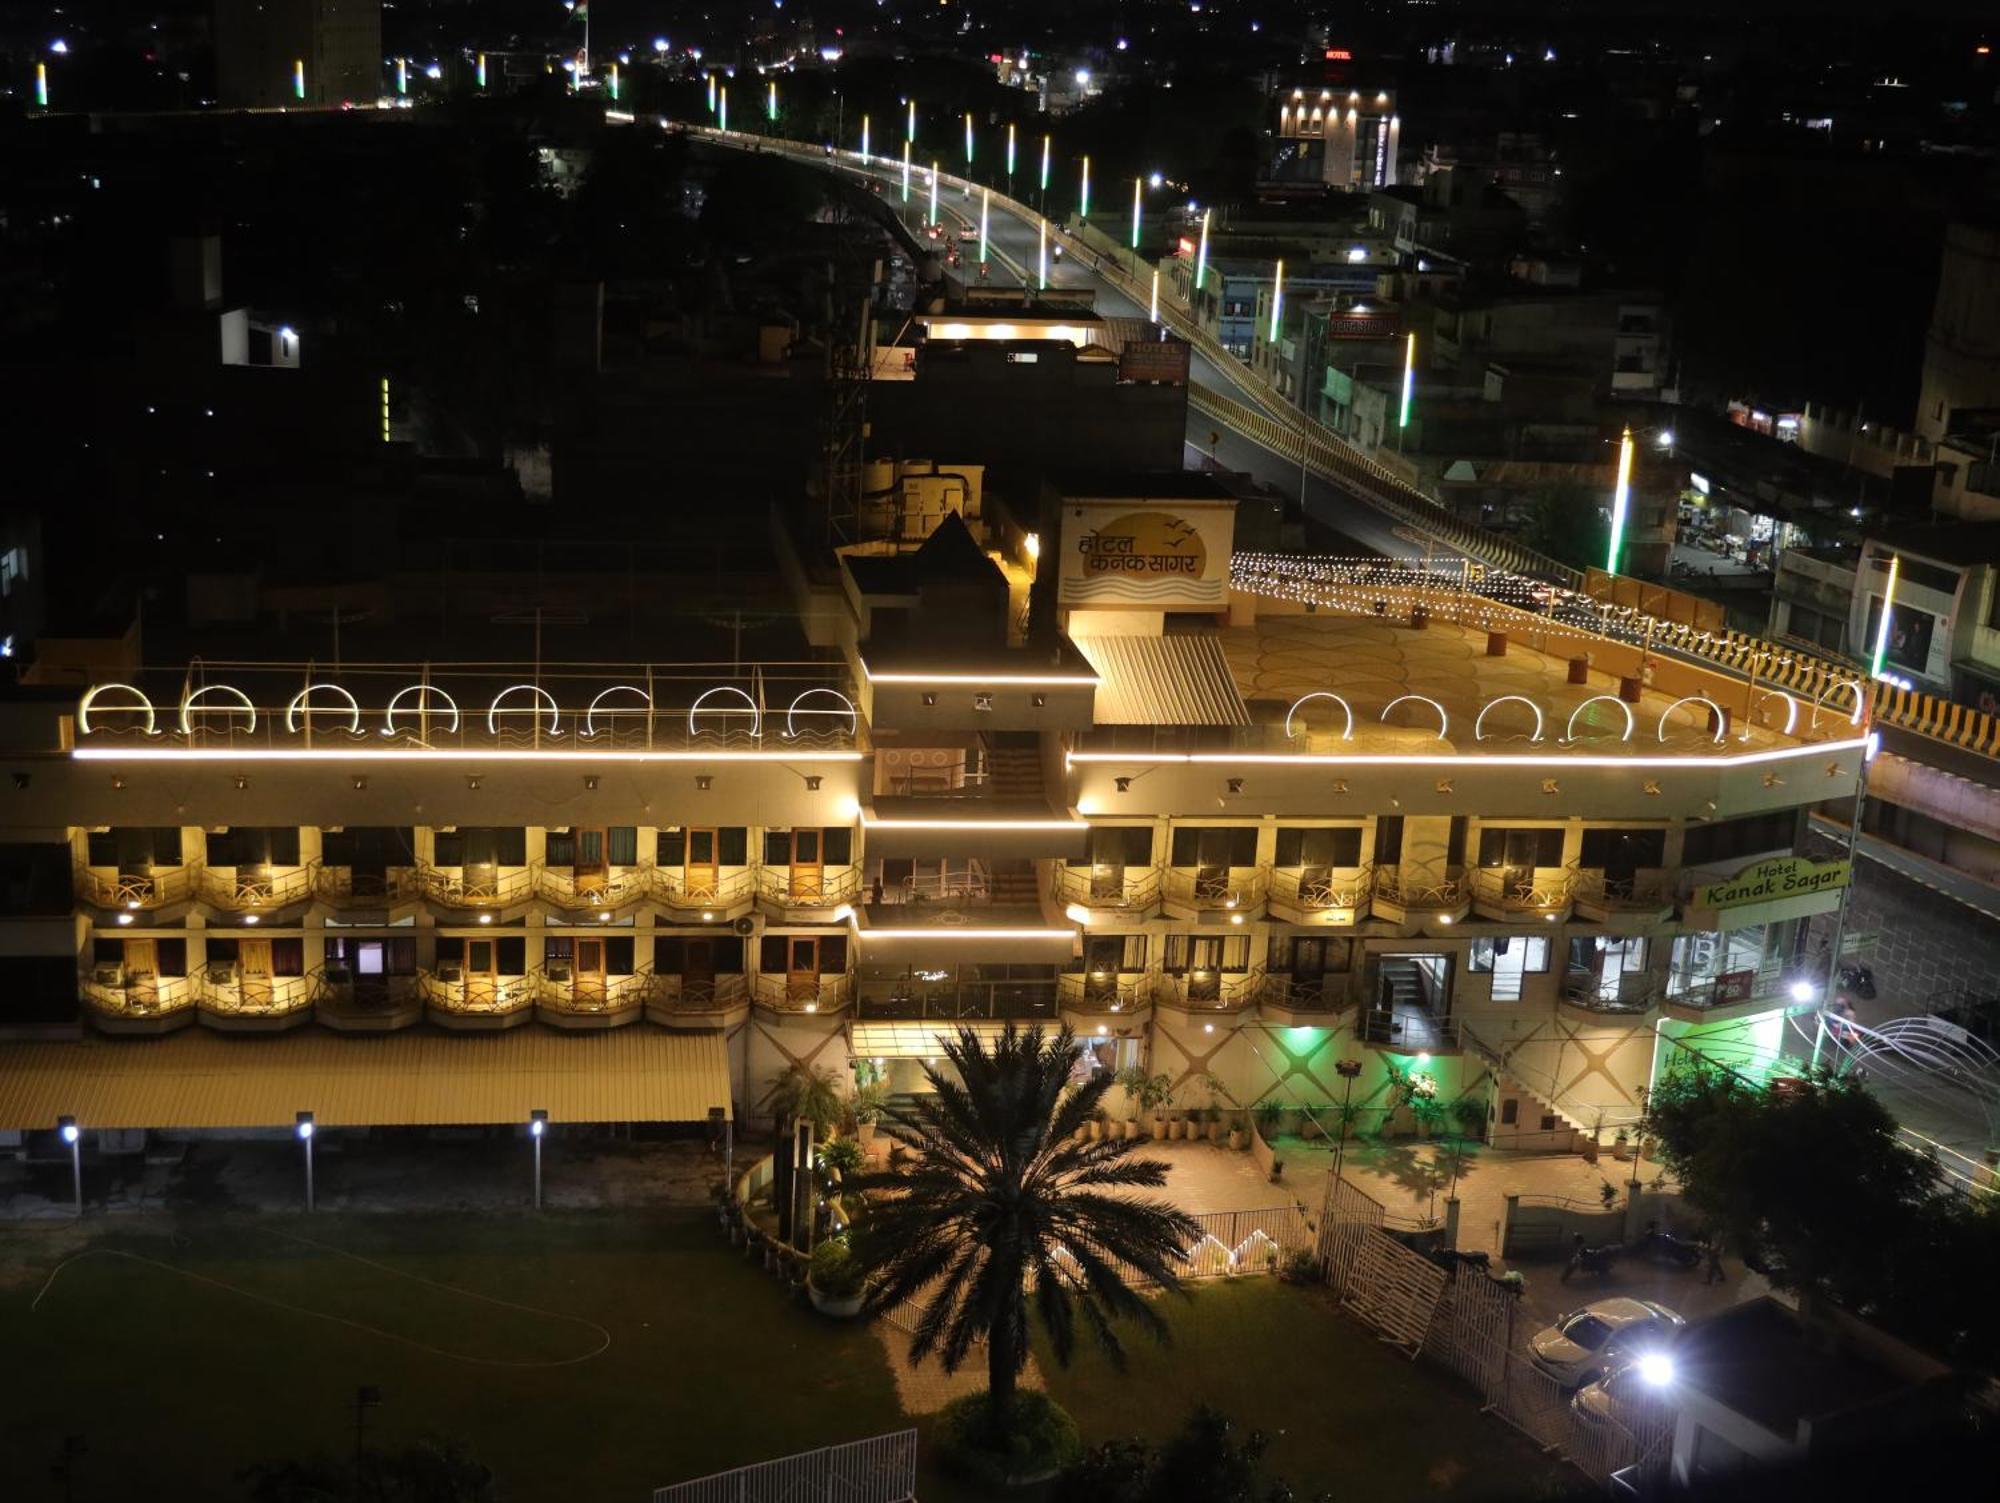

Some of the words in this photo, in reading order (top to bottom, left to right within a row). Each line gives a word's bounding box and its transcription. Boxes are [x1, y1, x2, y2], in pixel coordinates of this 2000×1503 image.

[1078, 529, 1136, 554] होटल
[1090, 554, 1147, 571] कनक
[1149, 555, 1199, 573] सागर
[1757, 861, 1798, 879] Hotel
[1707, 879, 1776, 905] Kanak
[1783, 869, 1842, 892] Sagar
